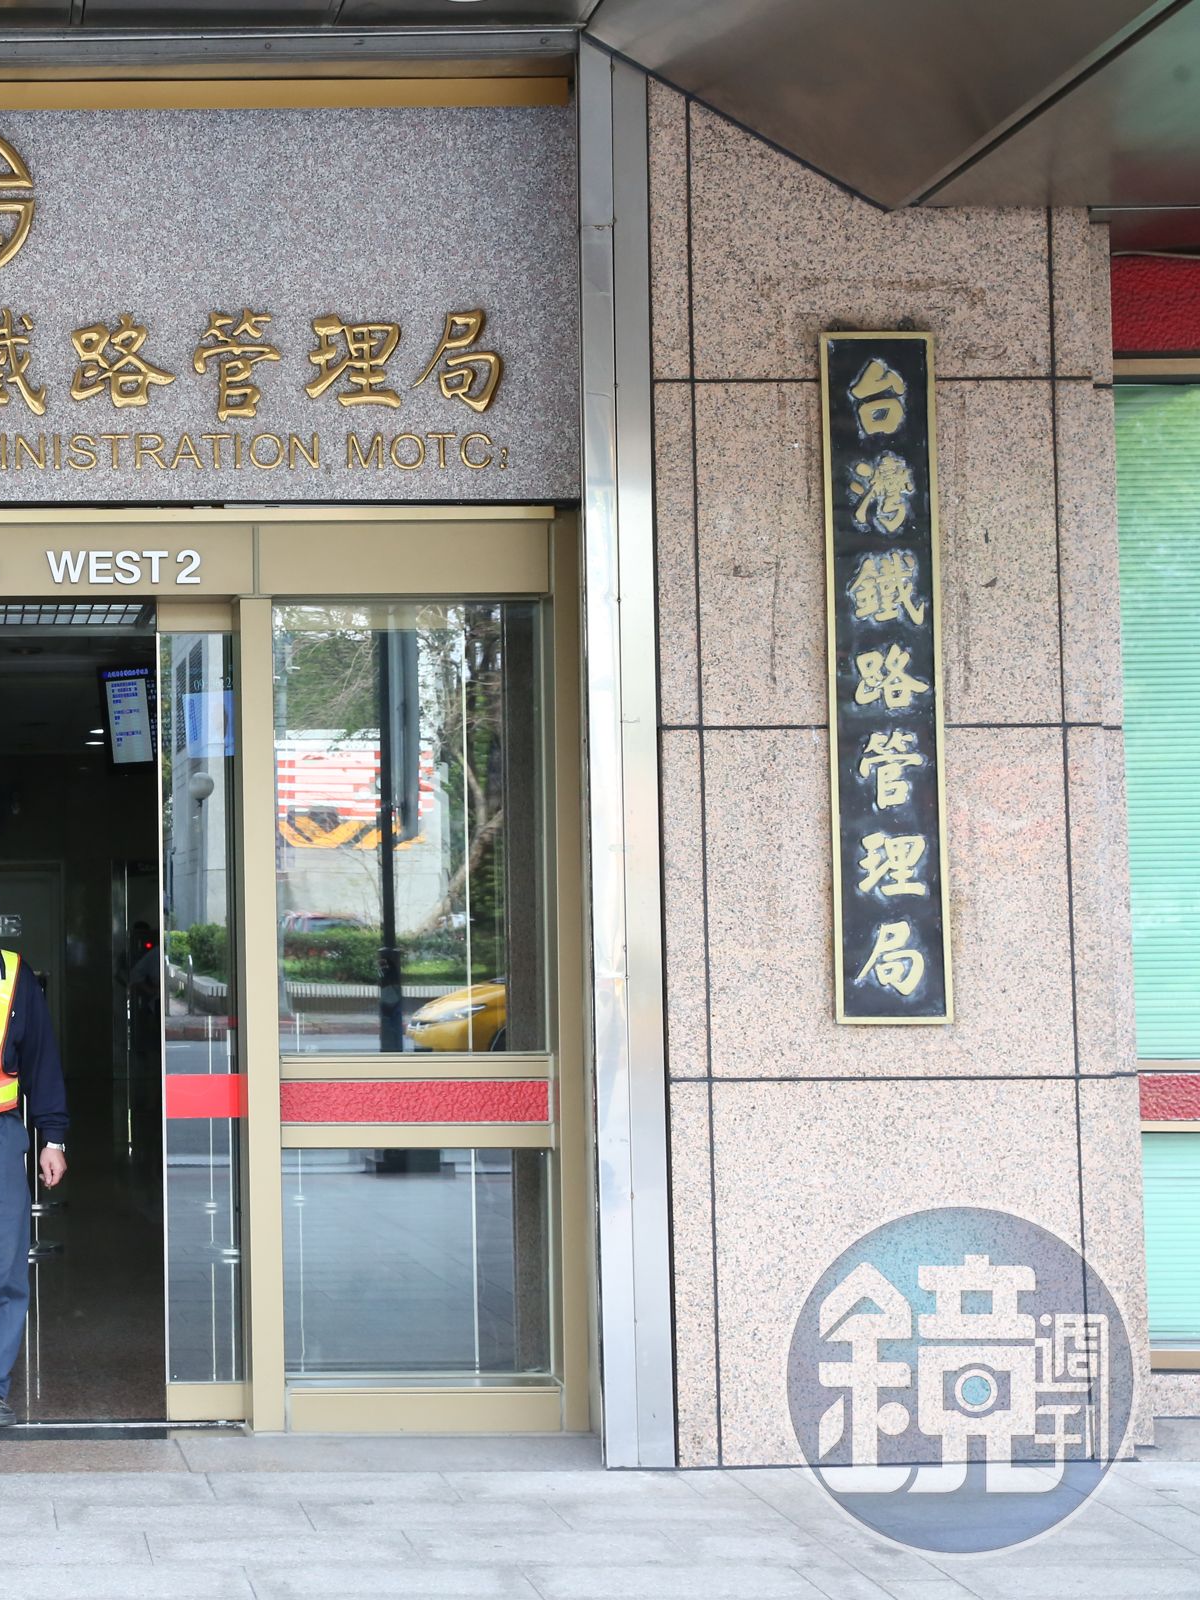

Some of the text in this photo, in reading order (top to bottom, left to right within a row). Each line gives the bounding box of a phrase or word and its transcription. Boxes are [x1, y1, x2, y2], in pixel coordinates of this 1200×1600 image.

[46, 549, 202, 585] WEST 2
[847, 357, 930, 998] 台灣鐵路管理局
